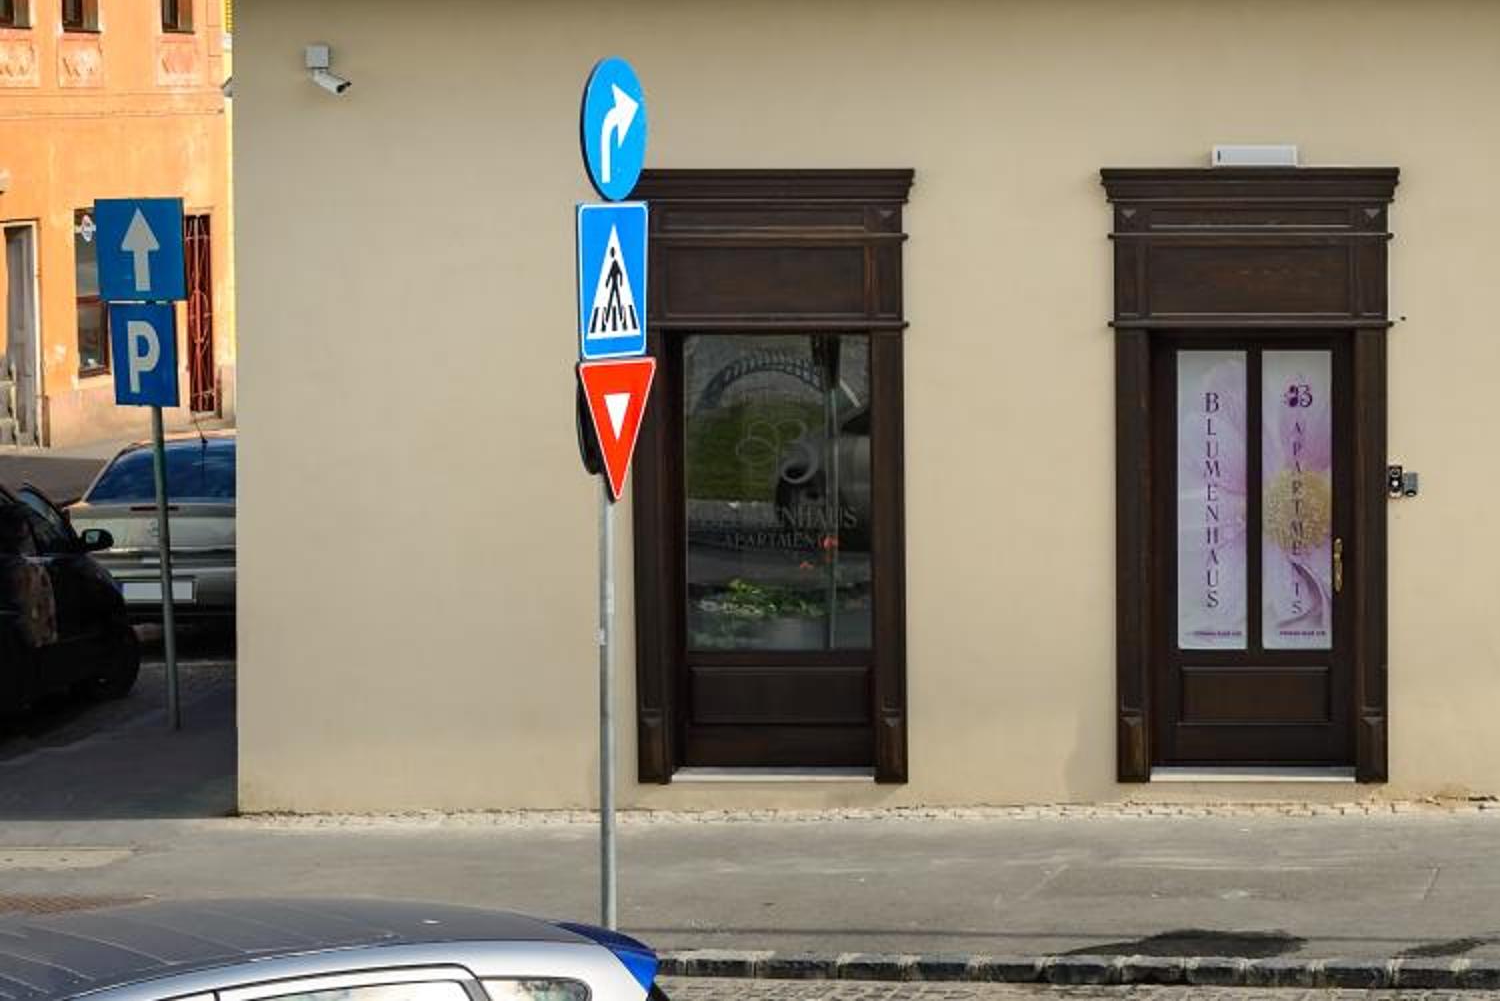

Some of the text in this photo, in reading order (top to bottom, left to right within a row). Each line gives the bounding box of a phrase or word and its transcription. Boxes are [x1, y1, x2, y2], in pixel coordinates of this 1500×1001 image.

[127, 320, 160, 394] P
[1203, 391, 1220, 608] BLUMENHAUS
[724, 532, 839, 549] APARTMEN
